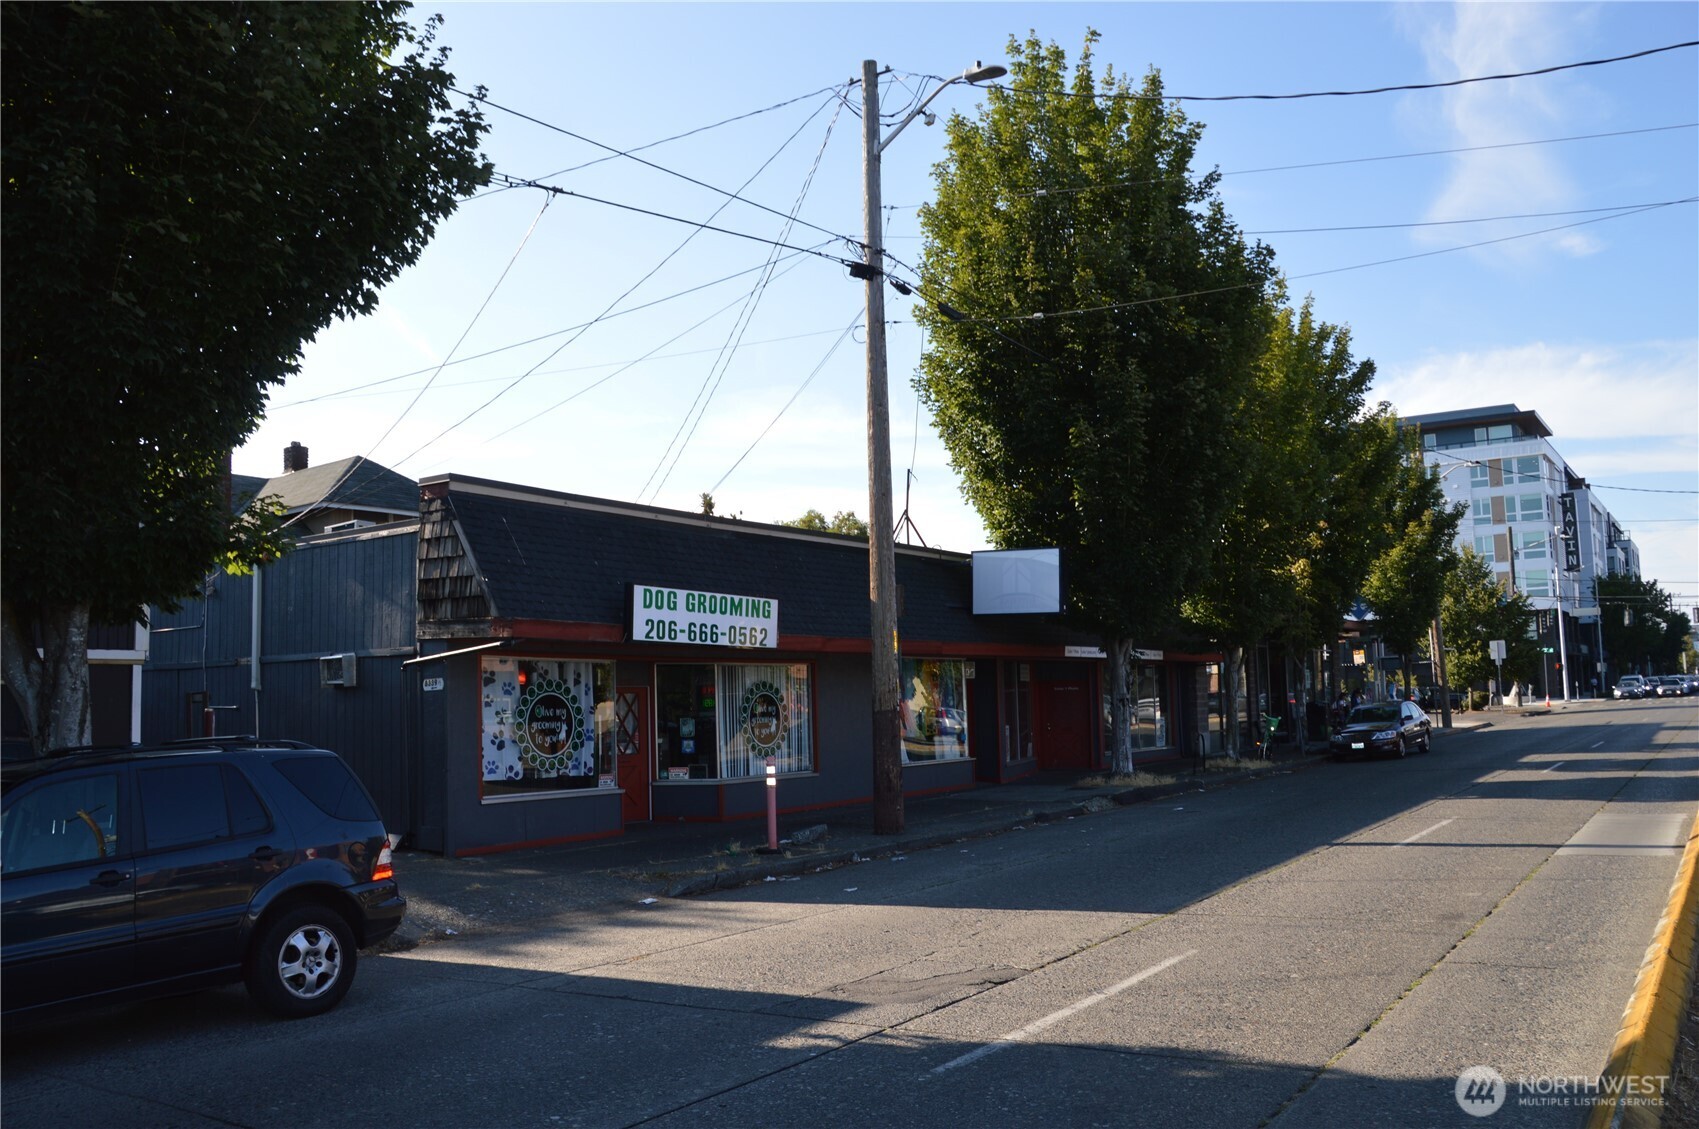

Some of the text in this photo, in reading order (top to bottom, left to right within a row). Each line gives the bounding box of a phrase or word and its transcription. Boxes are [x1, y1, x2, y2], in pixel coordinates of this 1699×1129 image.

[1563, 497, 1578, 566] TAVIN
[643, 588, 771, 619] DOG GROOMING
[645, 619, 767, 646] 206-666-0562
